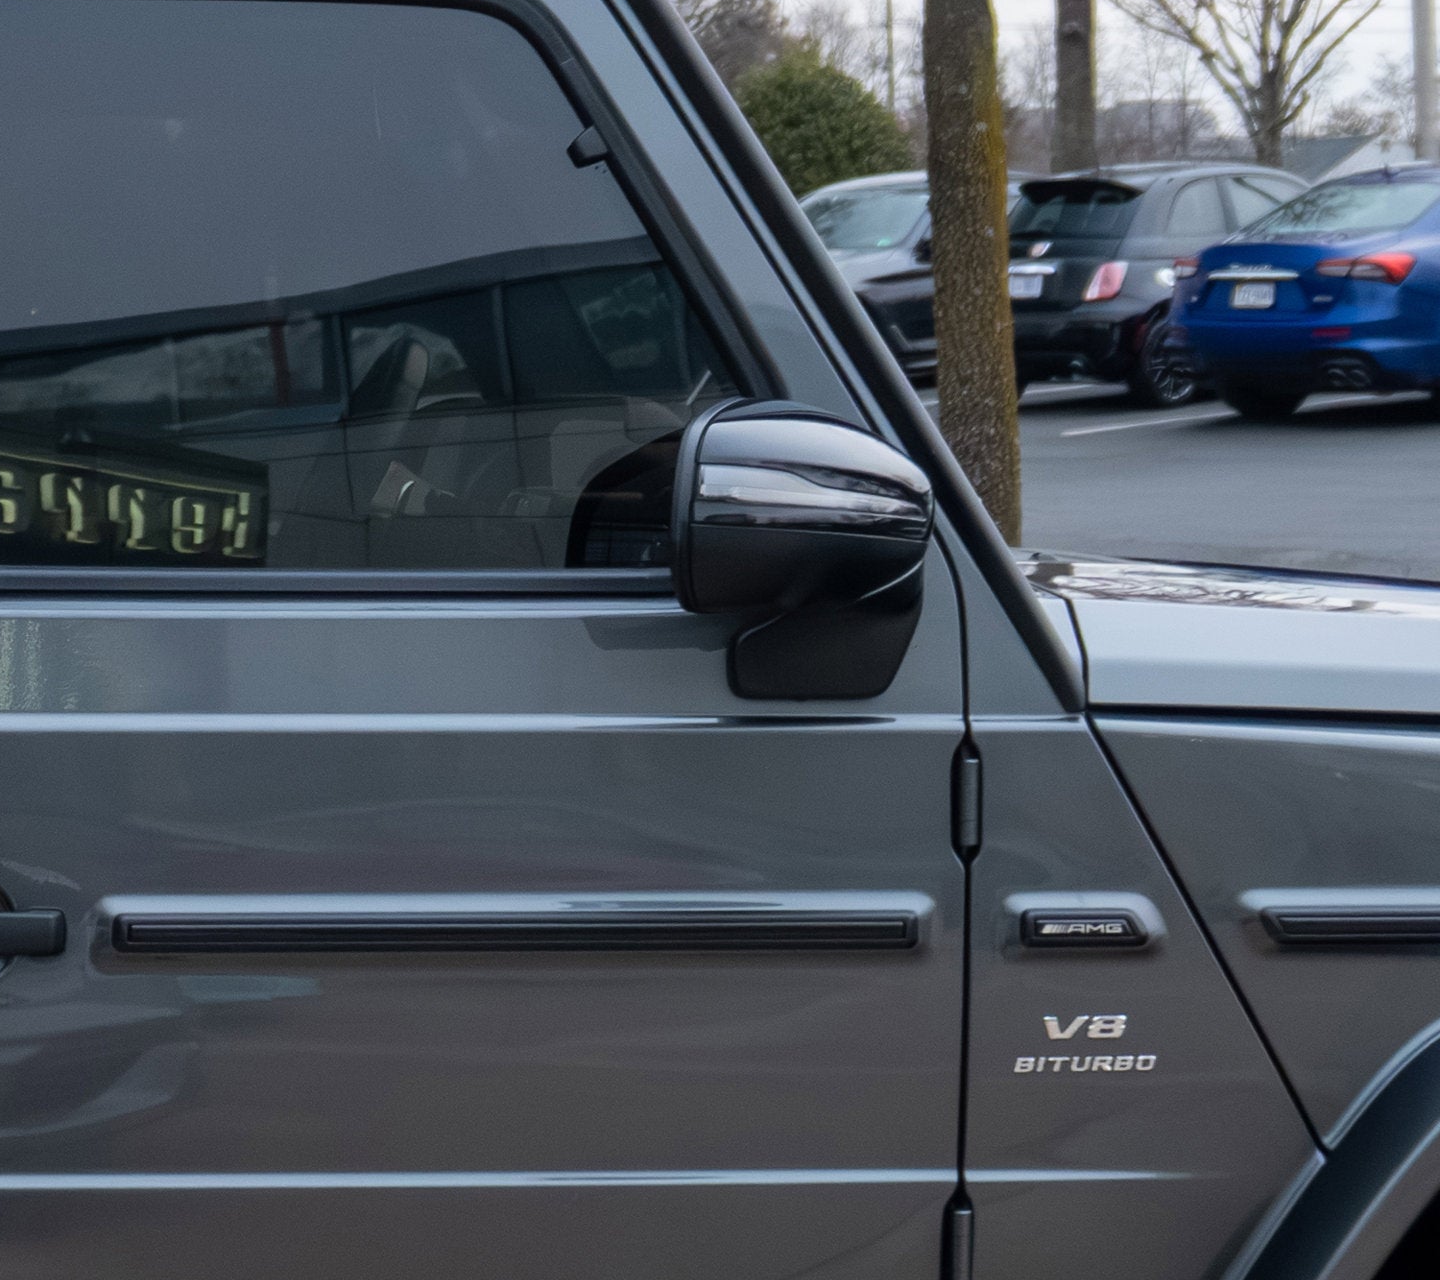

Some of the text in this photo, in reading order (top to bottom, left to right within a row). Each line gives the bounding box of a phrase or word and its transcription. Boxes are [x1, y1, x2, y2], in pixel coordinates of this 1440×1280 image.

[1064, 923, 1124, 935] AMG
[1043, 1014, 1128, 1040] V8
[1013, 1055, 1157, 1073] BITURBO
